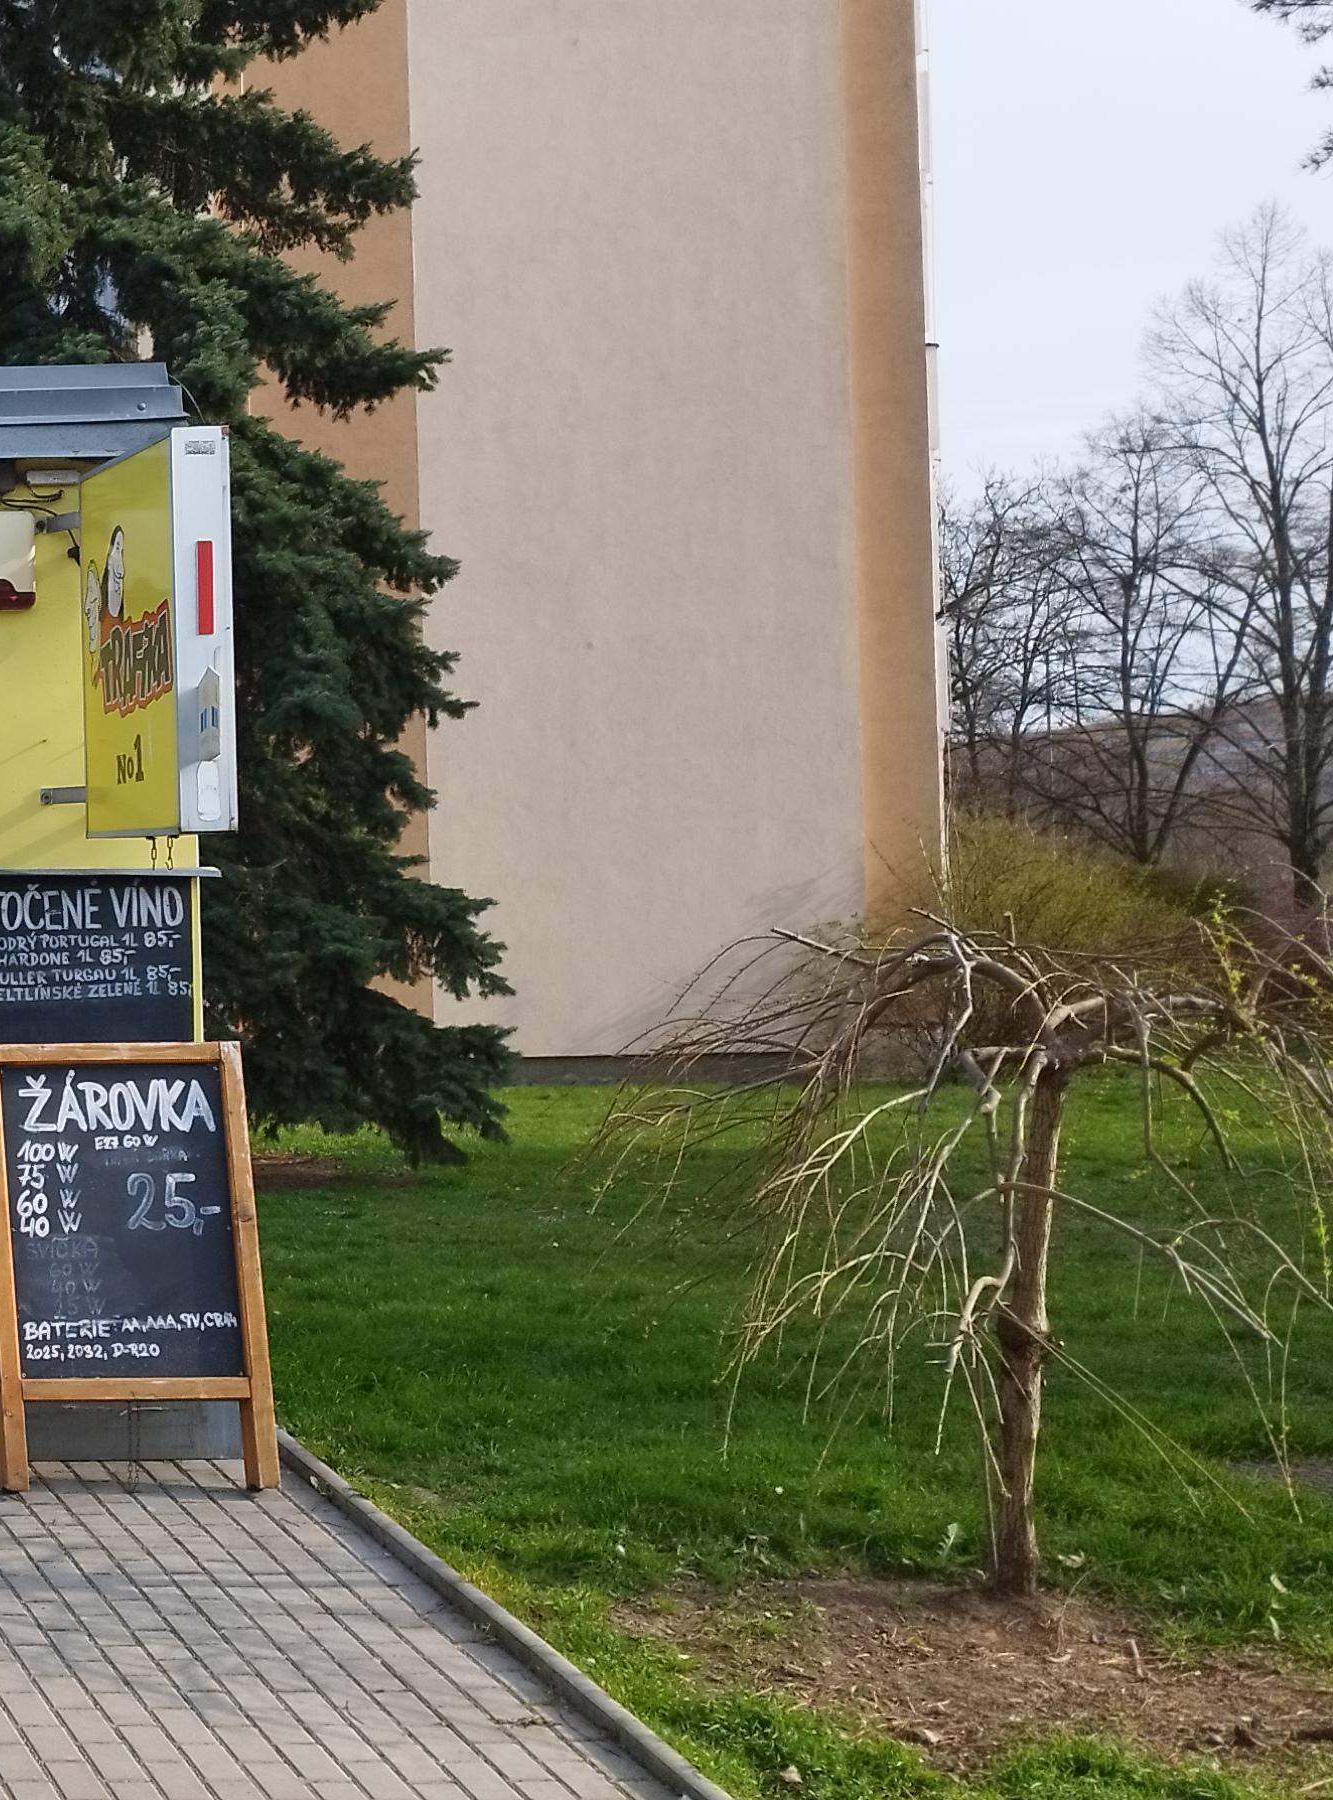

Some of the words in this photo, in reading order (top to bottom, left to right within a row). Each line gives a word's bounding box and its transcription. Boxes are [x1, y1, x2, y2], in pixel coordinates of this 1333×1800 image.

[109, 878, 184, 929] VÍNO
[40, 933, 119, 949] PORTUGAL
[51, 967, 116, 983] TURGAU
[87, 979, 143, 998] ZELENÉ
[18, 1069, 217, 1133] ŽÁROVKA
[17, 1139, 56, 1163] 100
[57, 1141, 80, 1163] W
[16, 1163, 46, 1190] 75
[55, 1162, 80, 1184] W
[16, 1189, 49, 1217] 60
[59, 1188, 82, 1209] W
[19, 1214, 51, 1239] 40
[57, 1209, 83, 1235] W
